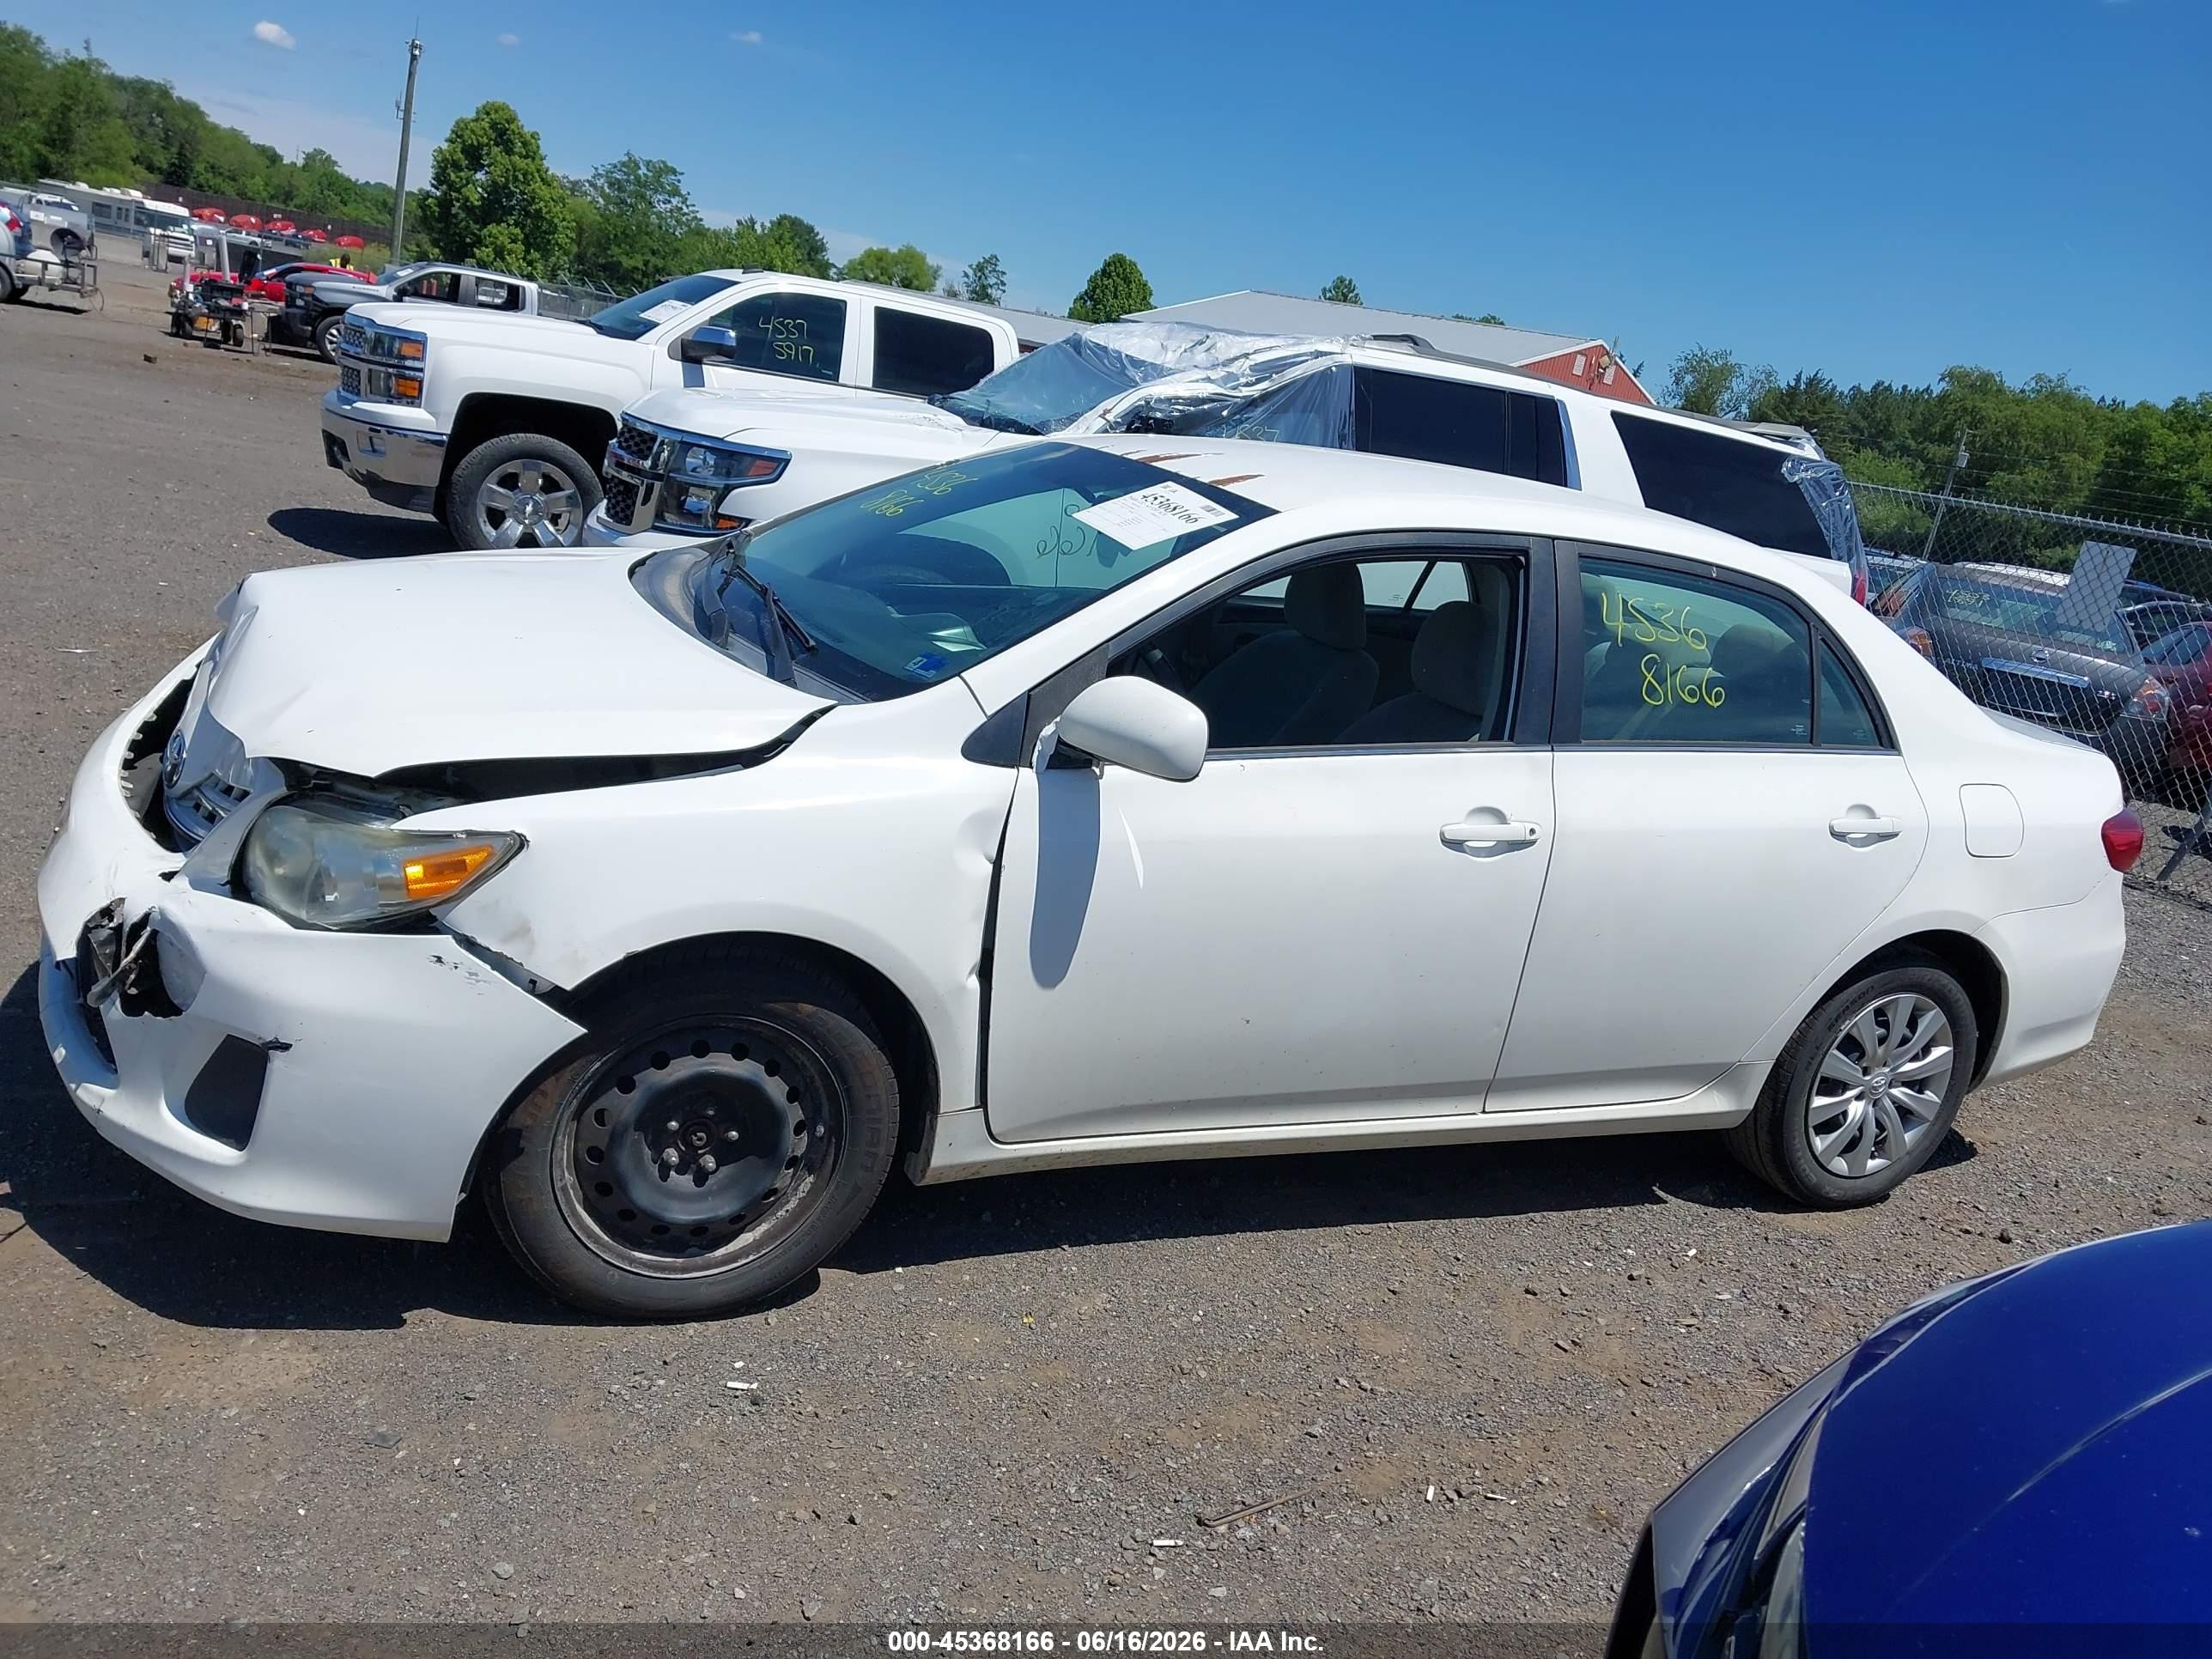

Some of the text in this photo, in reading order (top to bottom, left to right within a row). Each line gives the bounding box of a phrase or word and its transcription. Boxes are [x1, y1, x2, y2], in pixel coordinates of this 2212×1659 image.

[759, 315, 808, 339] 4537
[772, 341, 815, 365] 5917
[1140, 492, 1208, 524] 45368166
[1601, 591, 1708, 650] 4536
[1640, 653, 1726, 708] 8166
